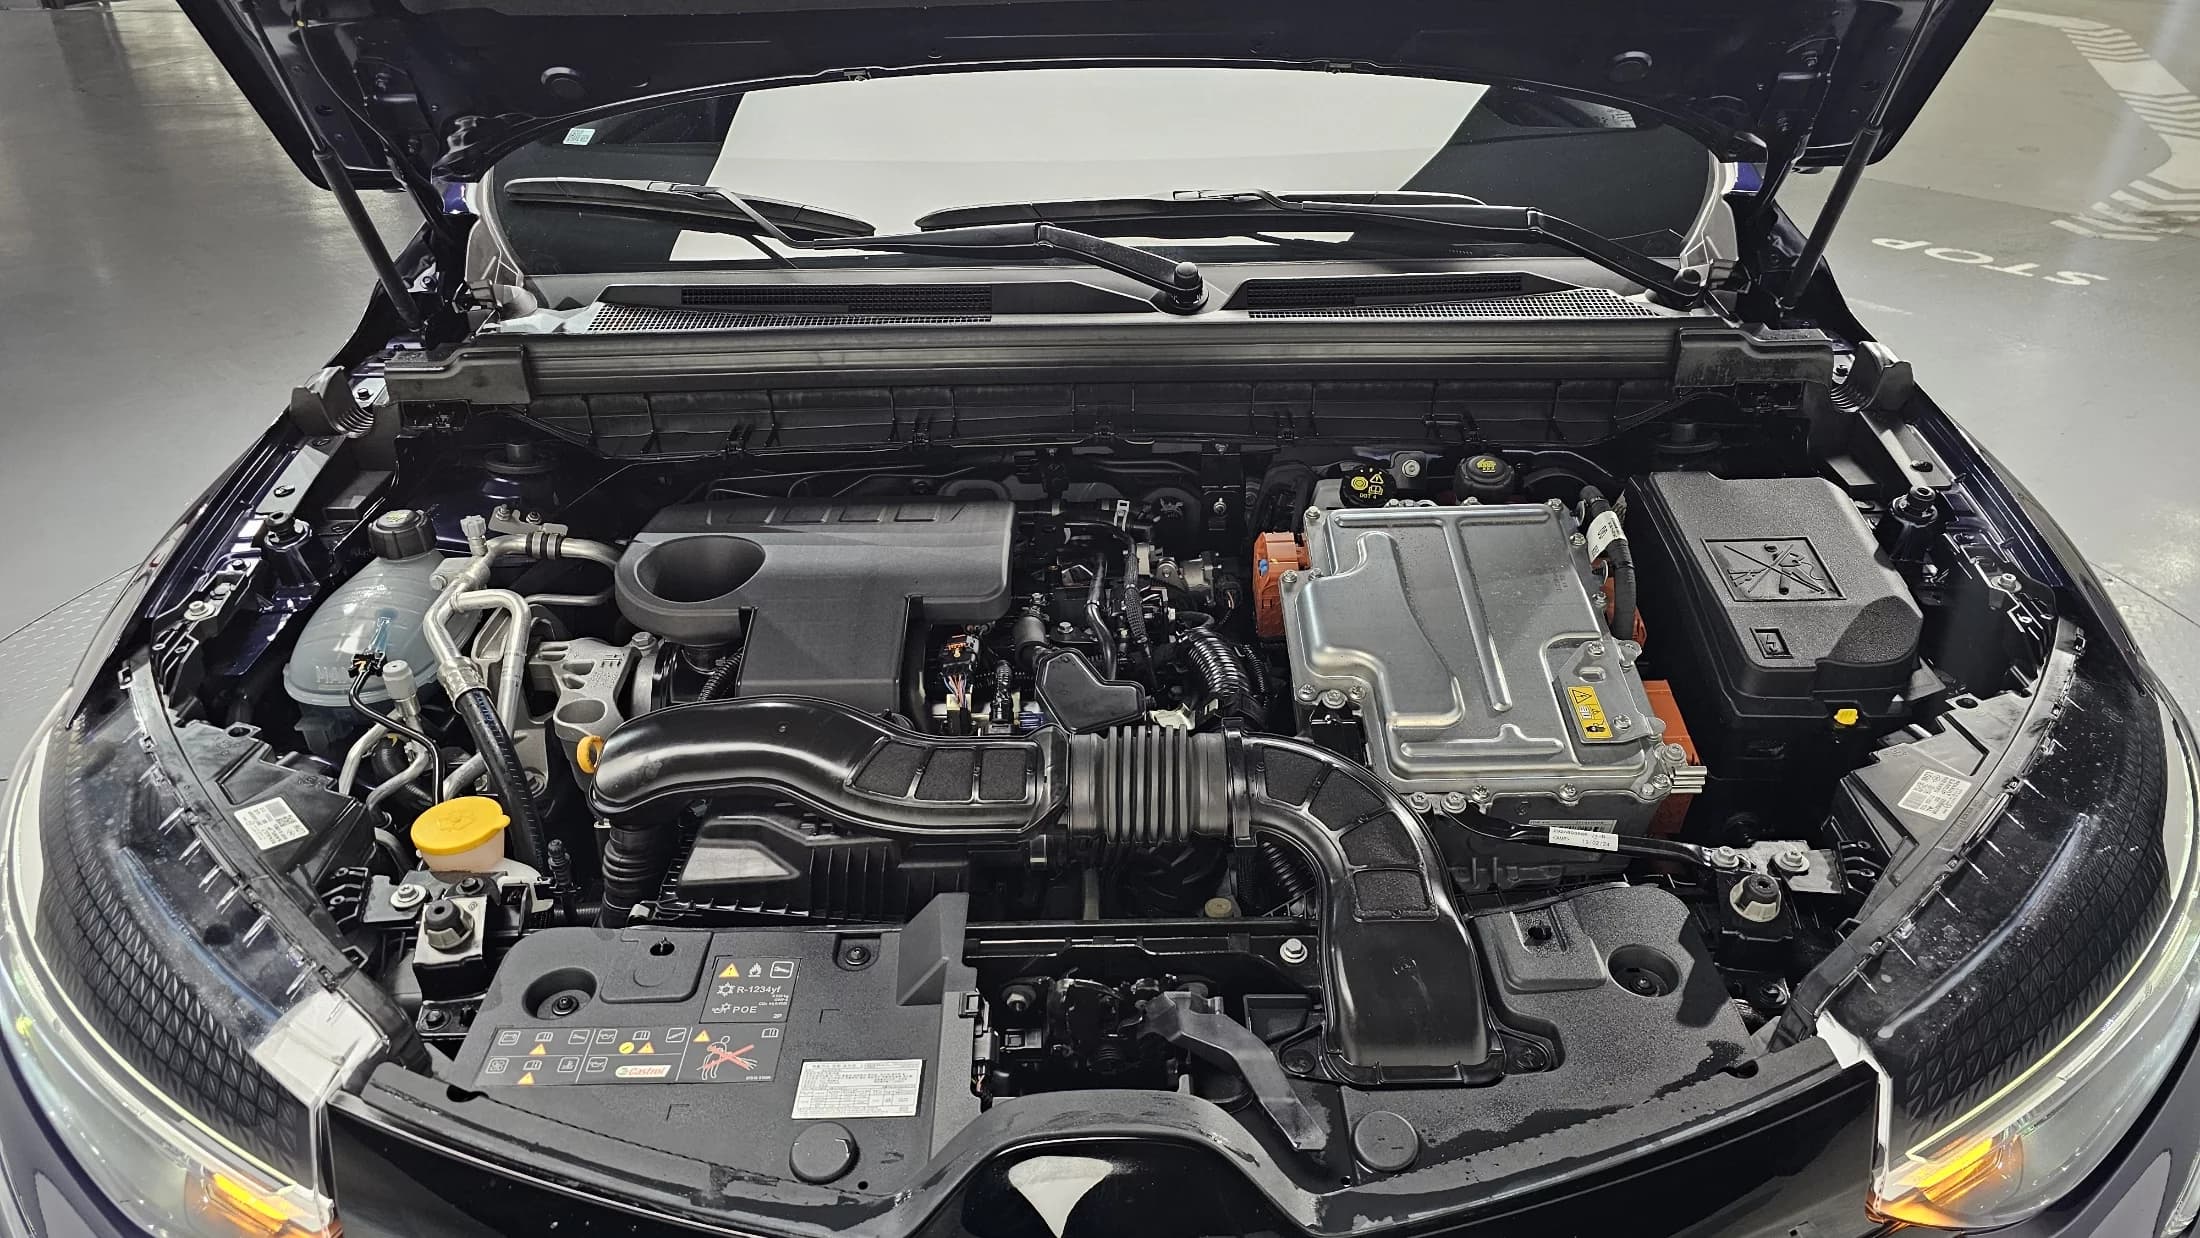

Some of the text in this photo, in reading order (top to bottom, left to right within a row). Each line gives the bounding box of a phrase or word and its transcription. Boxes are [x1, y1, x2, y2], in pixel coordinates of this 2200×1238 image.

[1871, 237, 2109, 286] STOP
[736, 985, 781, 995] R-1234yf
[732, 1005, 758, 1014] POE
[628, 1066, 667, 1077] Castrol
